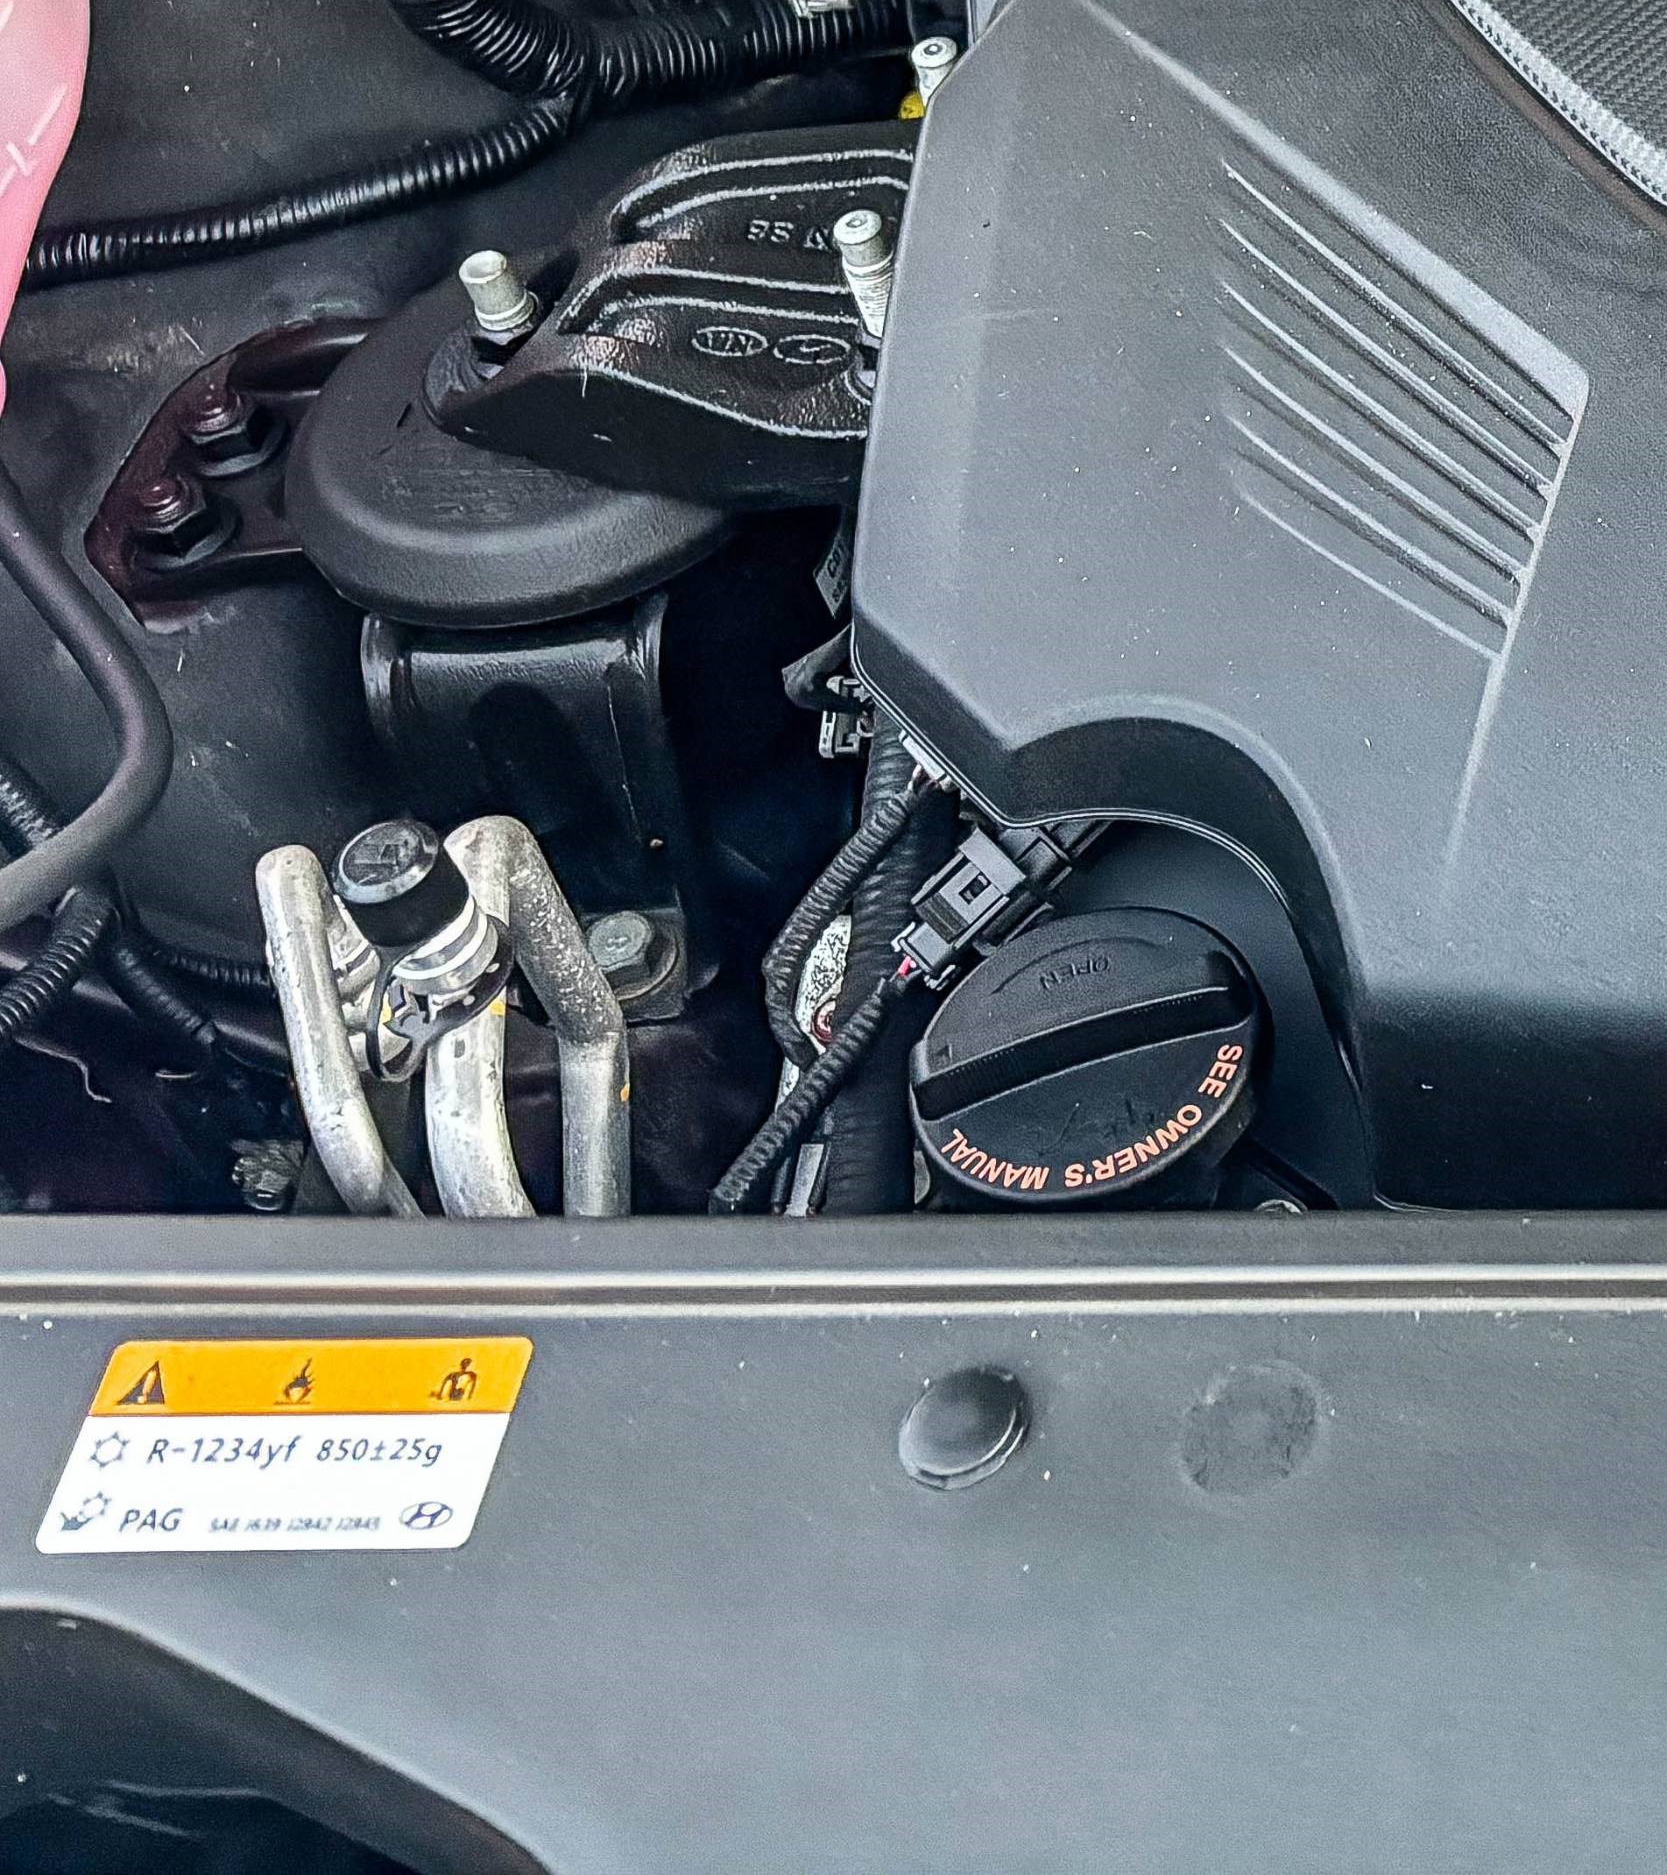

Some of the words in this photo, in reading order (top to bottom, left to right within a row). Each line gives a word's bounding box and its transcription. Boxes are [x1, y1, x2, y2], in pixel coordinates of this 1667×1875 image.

[1198, 1043, 1244, 1099] SEE
[941, 1128, 1051, 1190] MANUAL
[1064, 1104, 1204, 1189] OWNER'S
[146, 1435, 302, 1470] R-1234yf
[315, 1438, 443, 1468] 850±25g
[118, 1508, 184, 1533] PAG
